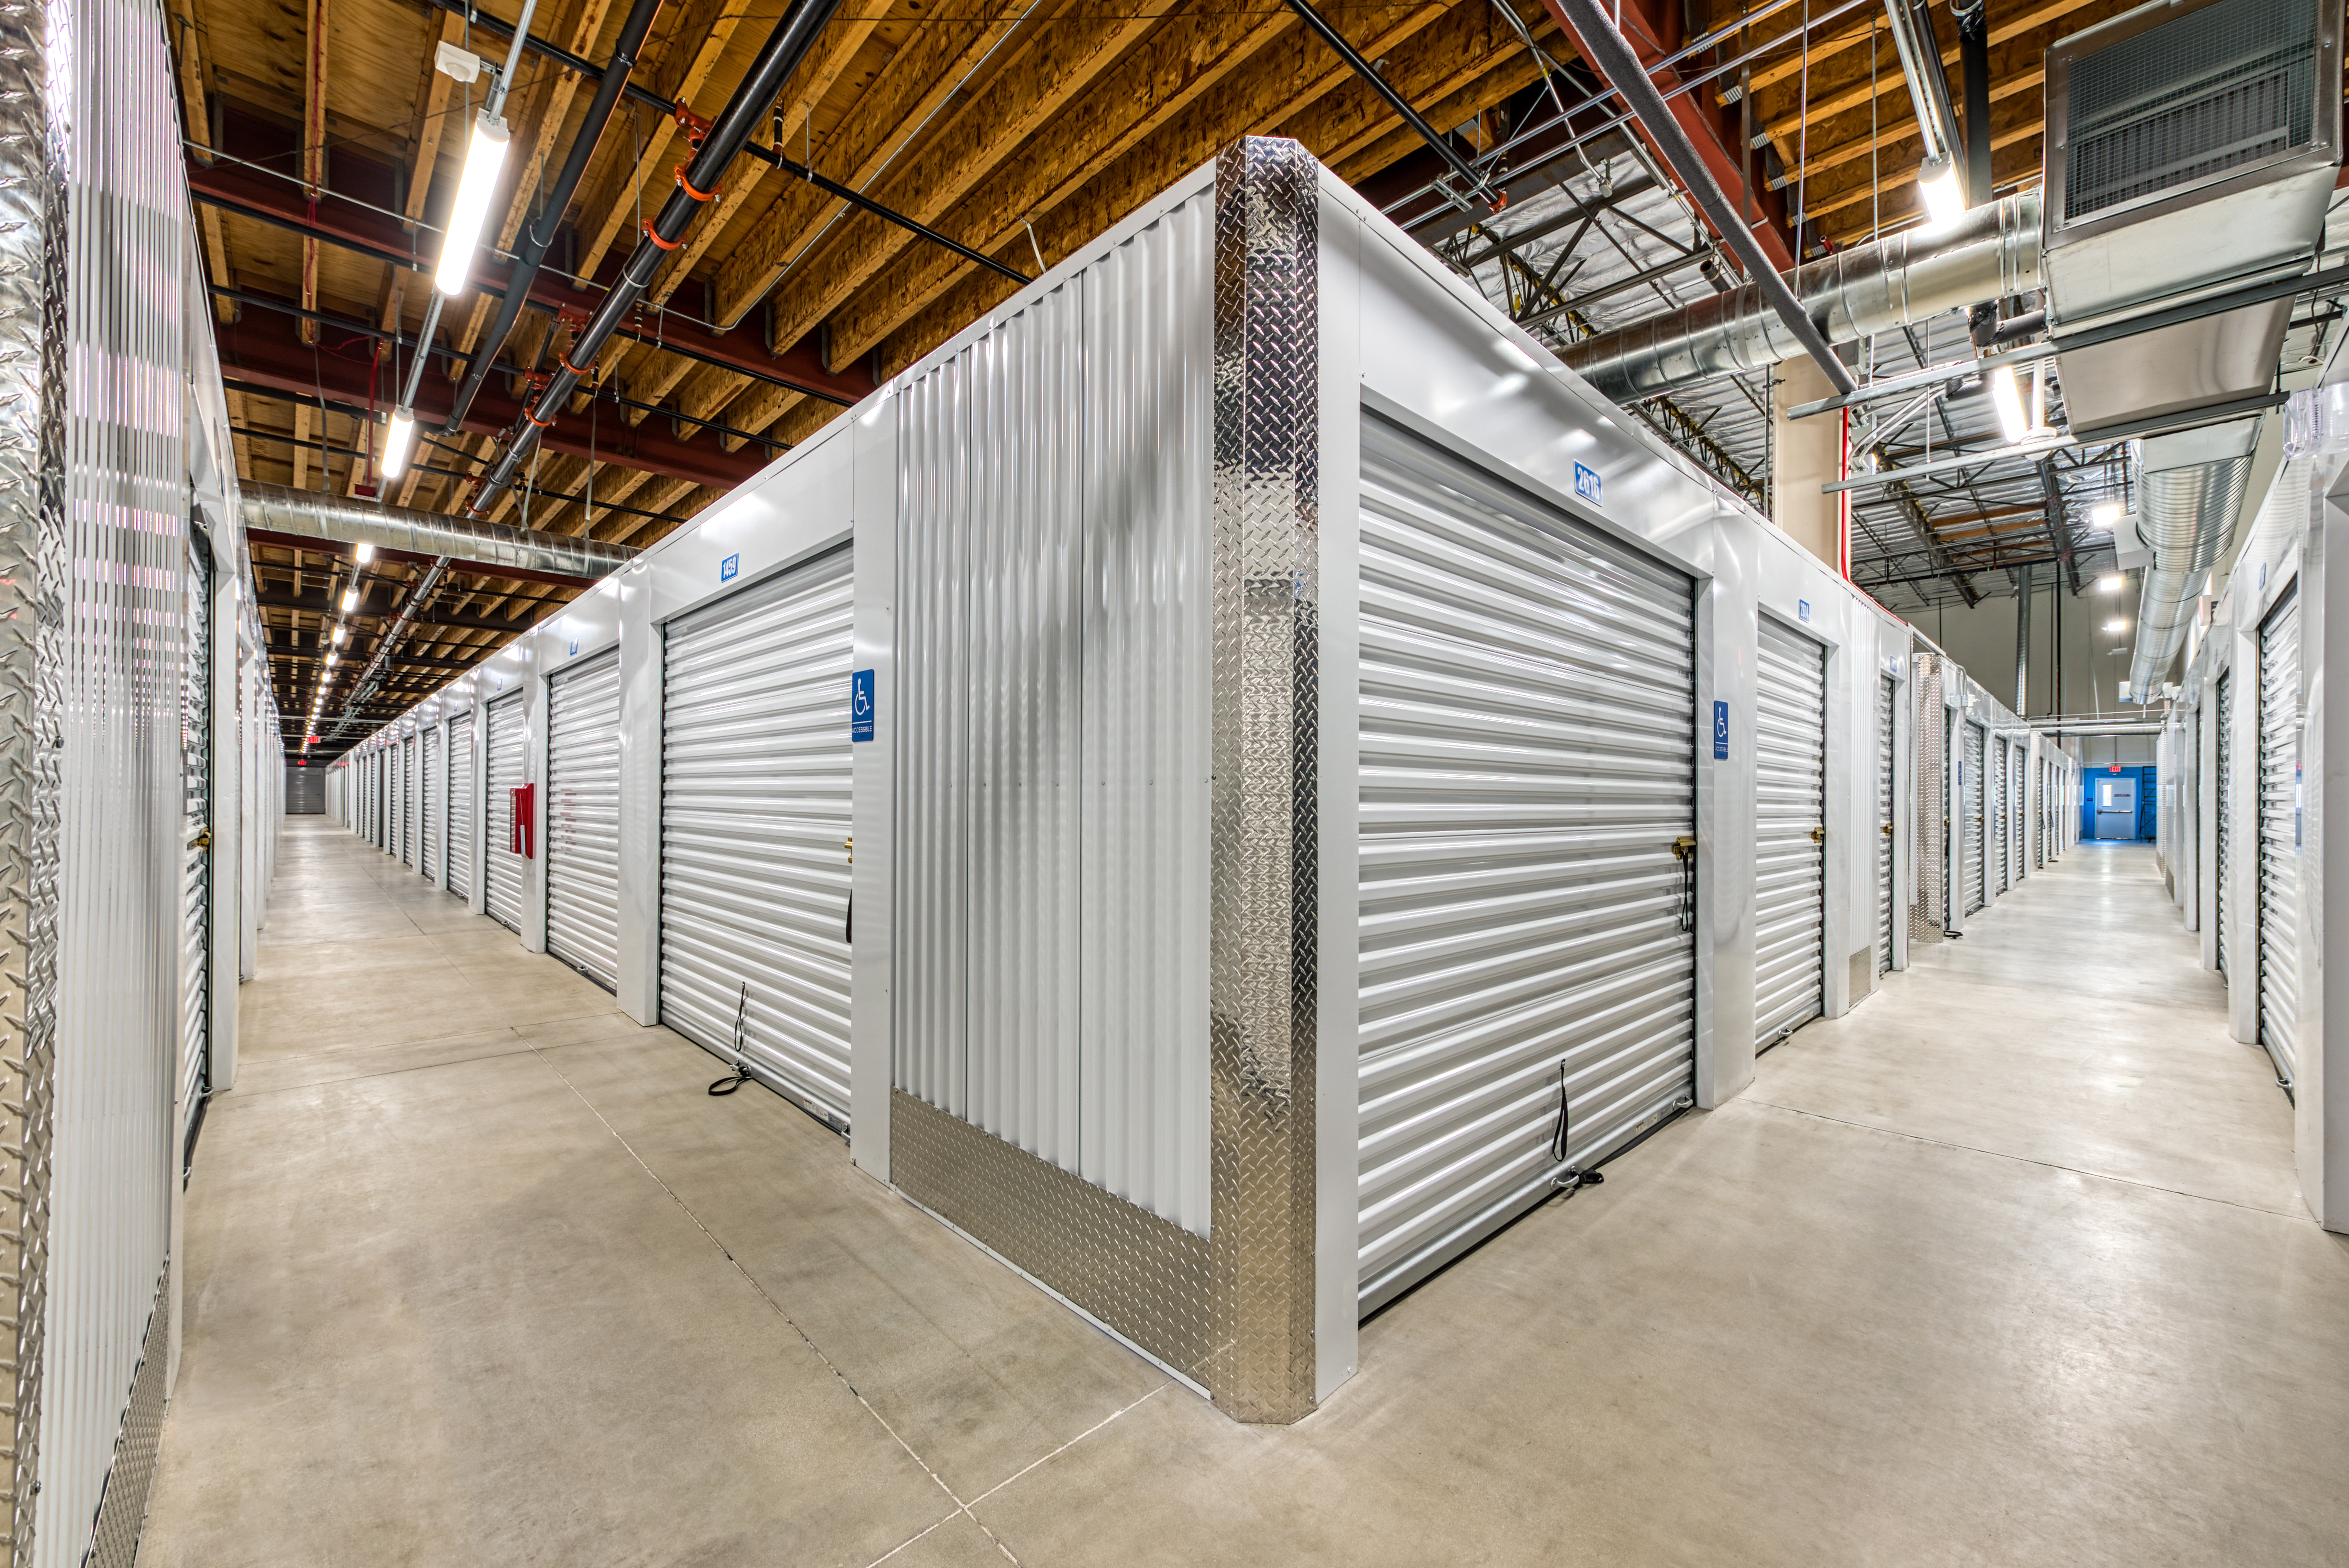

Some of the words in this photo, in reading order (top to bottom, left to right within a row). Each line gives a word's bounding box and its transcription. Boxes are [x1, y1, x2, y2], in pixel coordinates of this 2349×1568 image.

[1578, 467, 1600, 500] 2616
[723, 556, 736, 578] 1459
[1800, 602, 1809, 620] 2614
